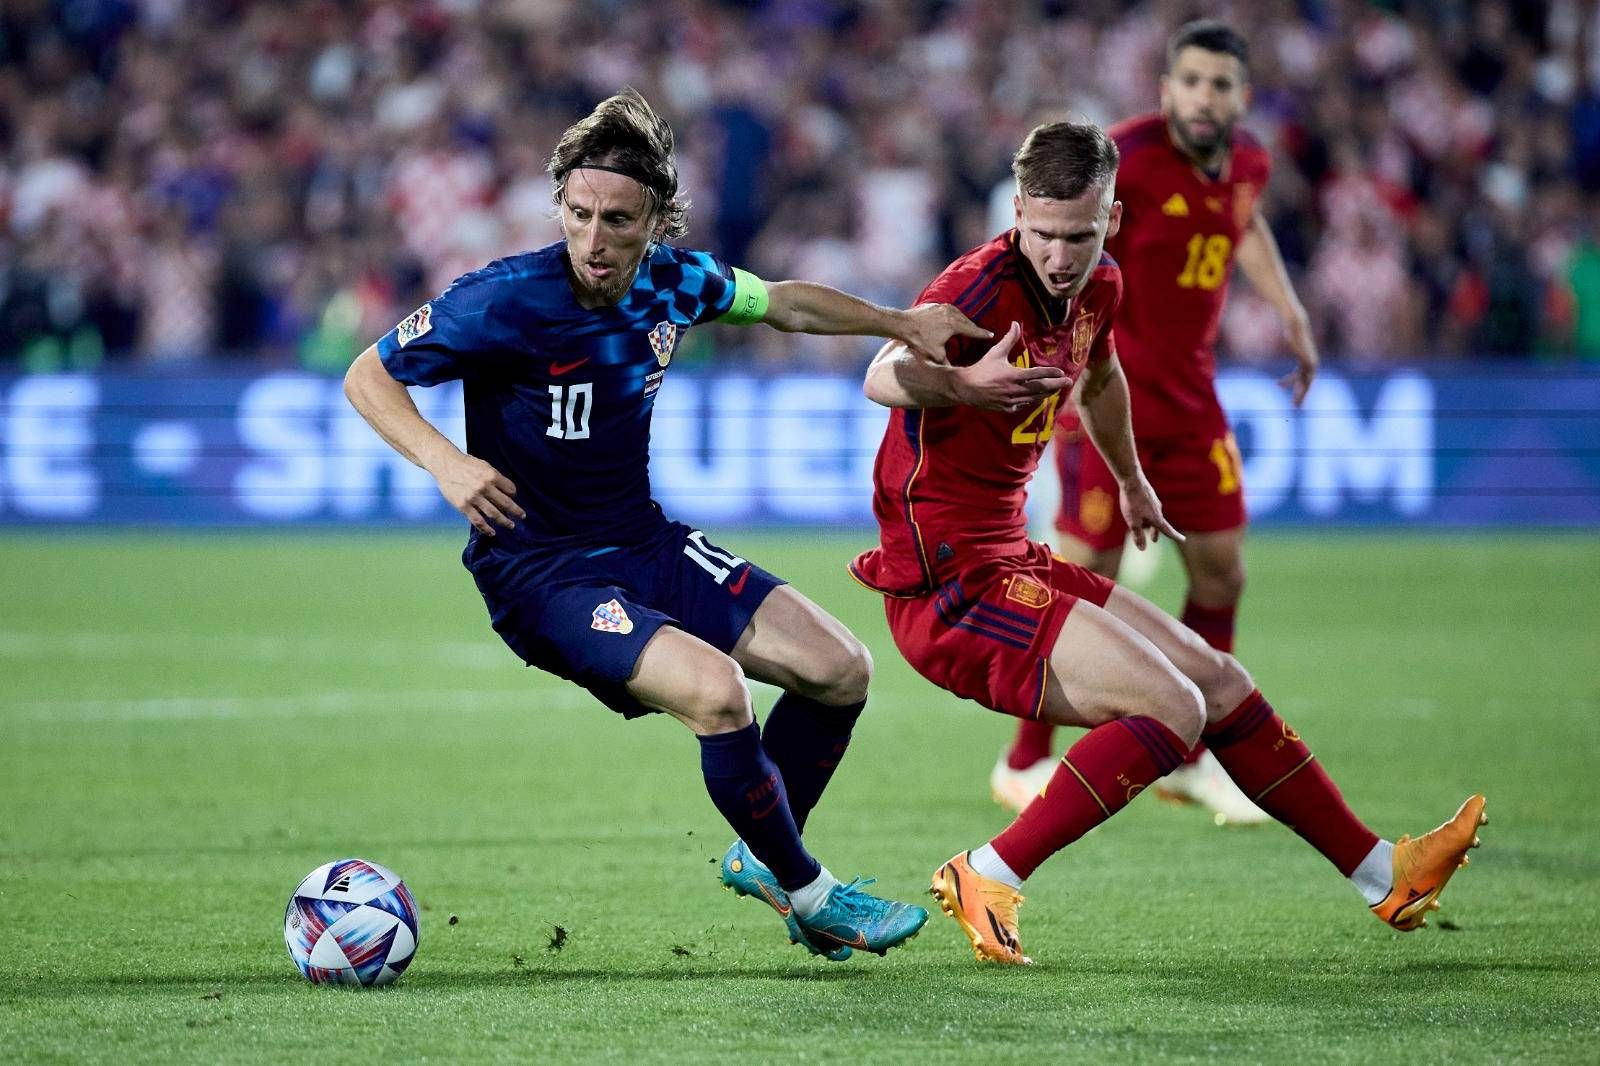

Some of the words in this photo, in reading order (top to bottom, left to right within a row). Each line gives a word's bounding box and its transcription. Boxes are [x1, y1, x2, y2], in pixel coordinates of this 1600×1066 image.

[1177, 233, 1231, 290] 18
[546, 383, 593, 439] 10
[684, 530, 747, 585] 10
